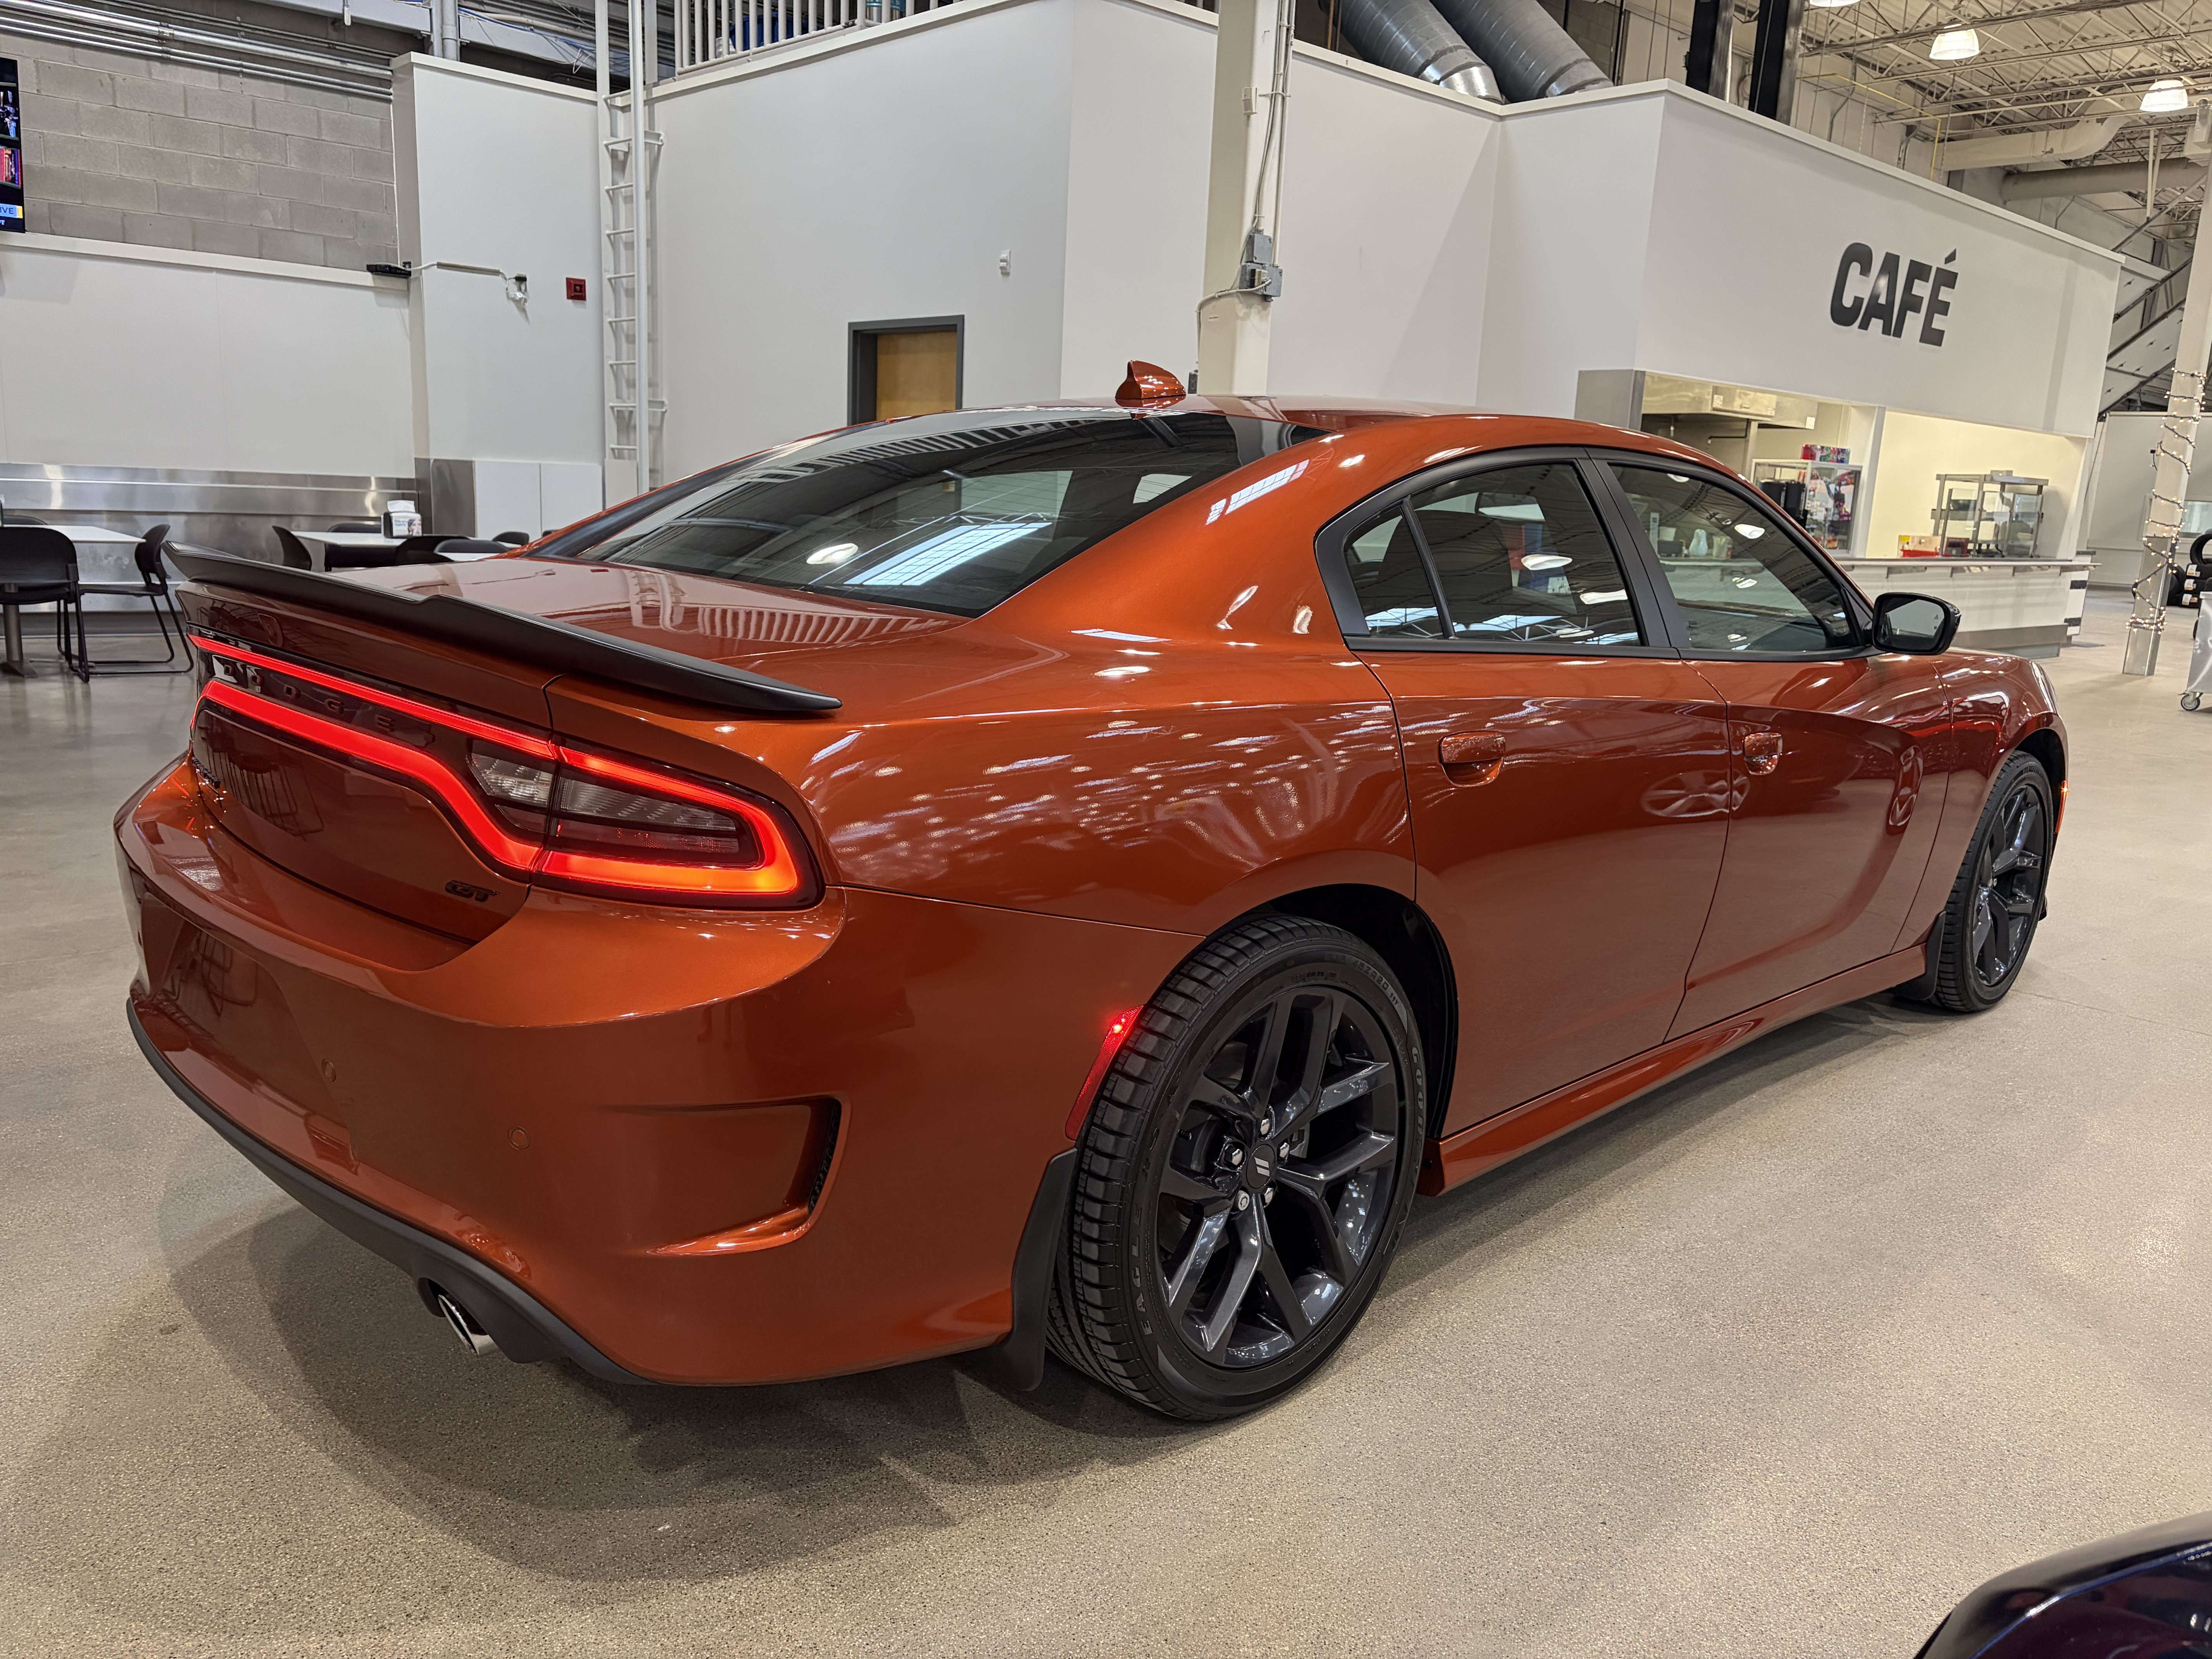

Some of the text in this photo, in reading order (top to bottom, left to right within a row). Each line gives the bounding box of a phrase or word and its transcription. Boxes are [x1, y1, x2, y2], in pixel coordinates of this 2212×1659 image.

[1830, 242, 1959, 347] CAFÉ
[223, 664, 395, 732] DODGE
[445, 880, 499, 903] GT
[1132, 1204, 1153, 1335] EAGLE
